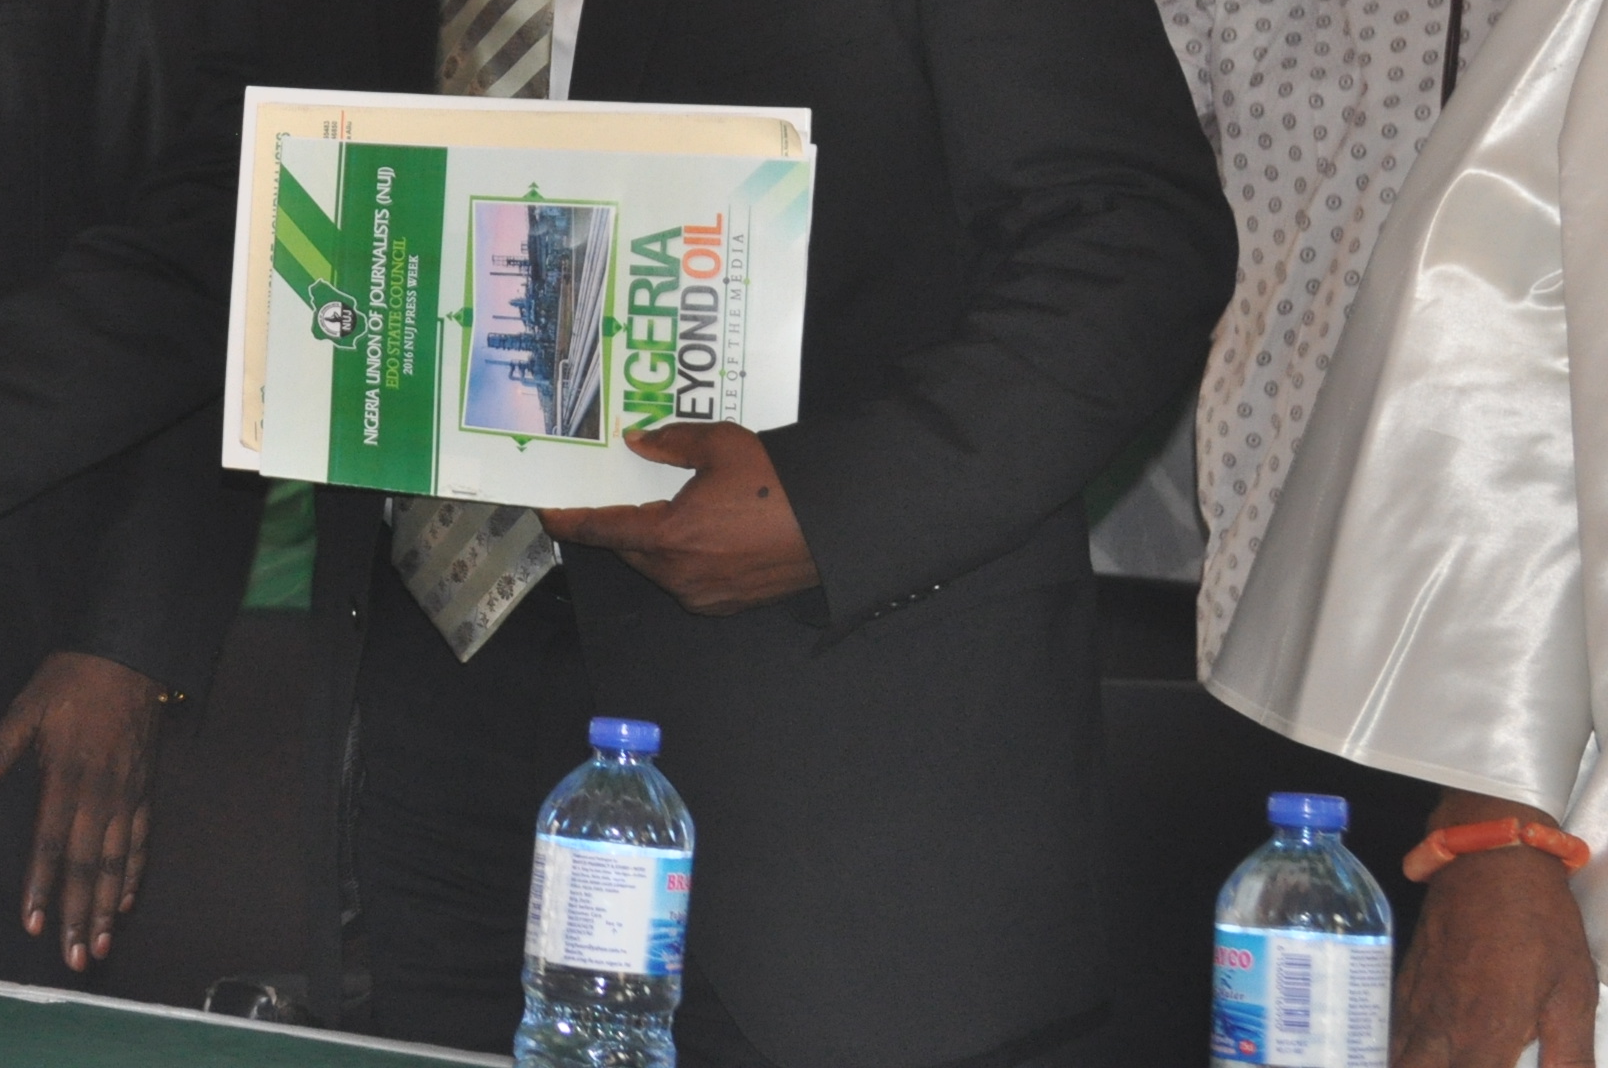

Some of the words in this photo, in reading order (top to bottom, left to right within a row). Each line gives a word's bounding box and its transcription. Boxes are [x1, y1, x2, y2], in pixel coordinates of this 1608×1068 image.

[376, 166, 396, 204] (NUJ)
[370, 209, 389, 309] JOURNALISTS
[682, 213, 722, 279] OIL
[389, 237, 406, 308] COUNCIL
[407, 254, 419, 288] WEEK
[730, 234, 744, 300] MEDIA
[342, 310, 352, 331] NUJ
[368, 310, 383, 331] OF
[405, 290, 417, 324] PRESS
[387, 311, 401, 355] STATE
[404, 326, 417, 349] NUJ
[622, 226, 682, 438] NIGERIA
[728, 309, 740, 348] THE
[365, 334, 382, 384] UNION
[403, 352, 414, 375] 2016
[675, 286, 719, 420] EYOND
[726, 357, 738, 381] OF
[386, 358, 400, 390] EDO
[364, 388, 380, 445] NIGERIA
